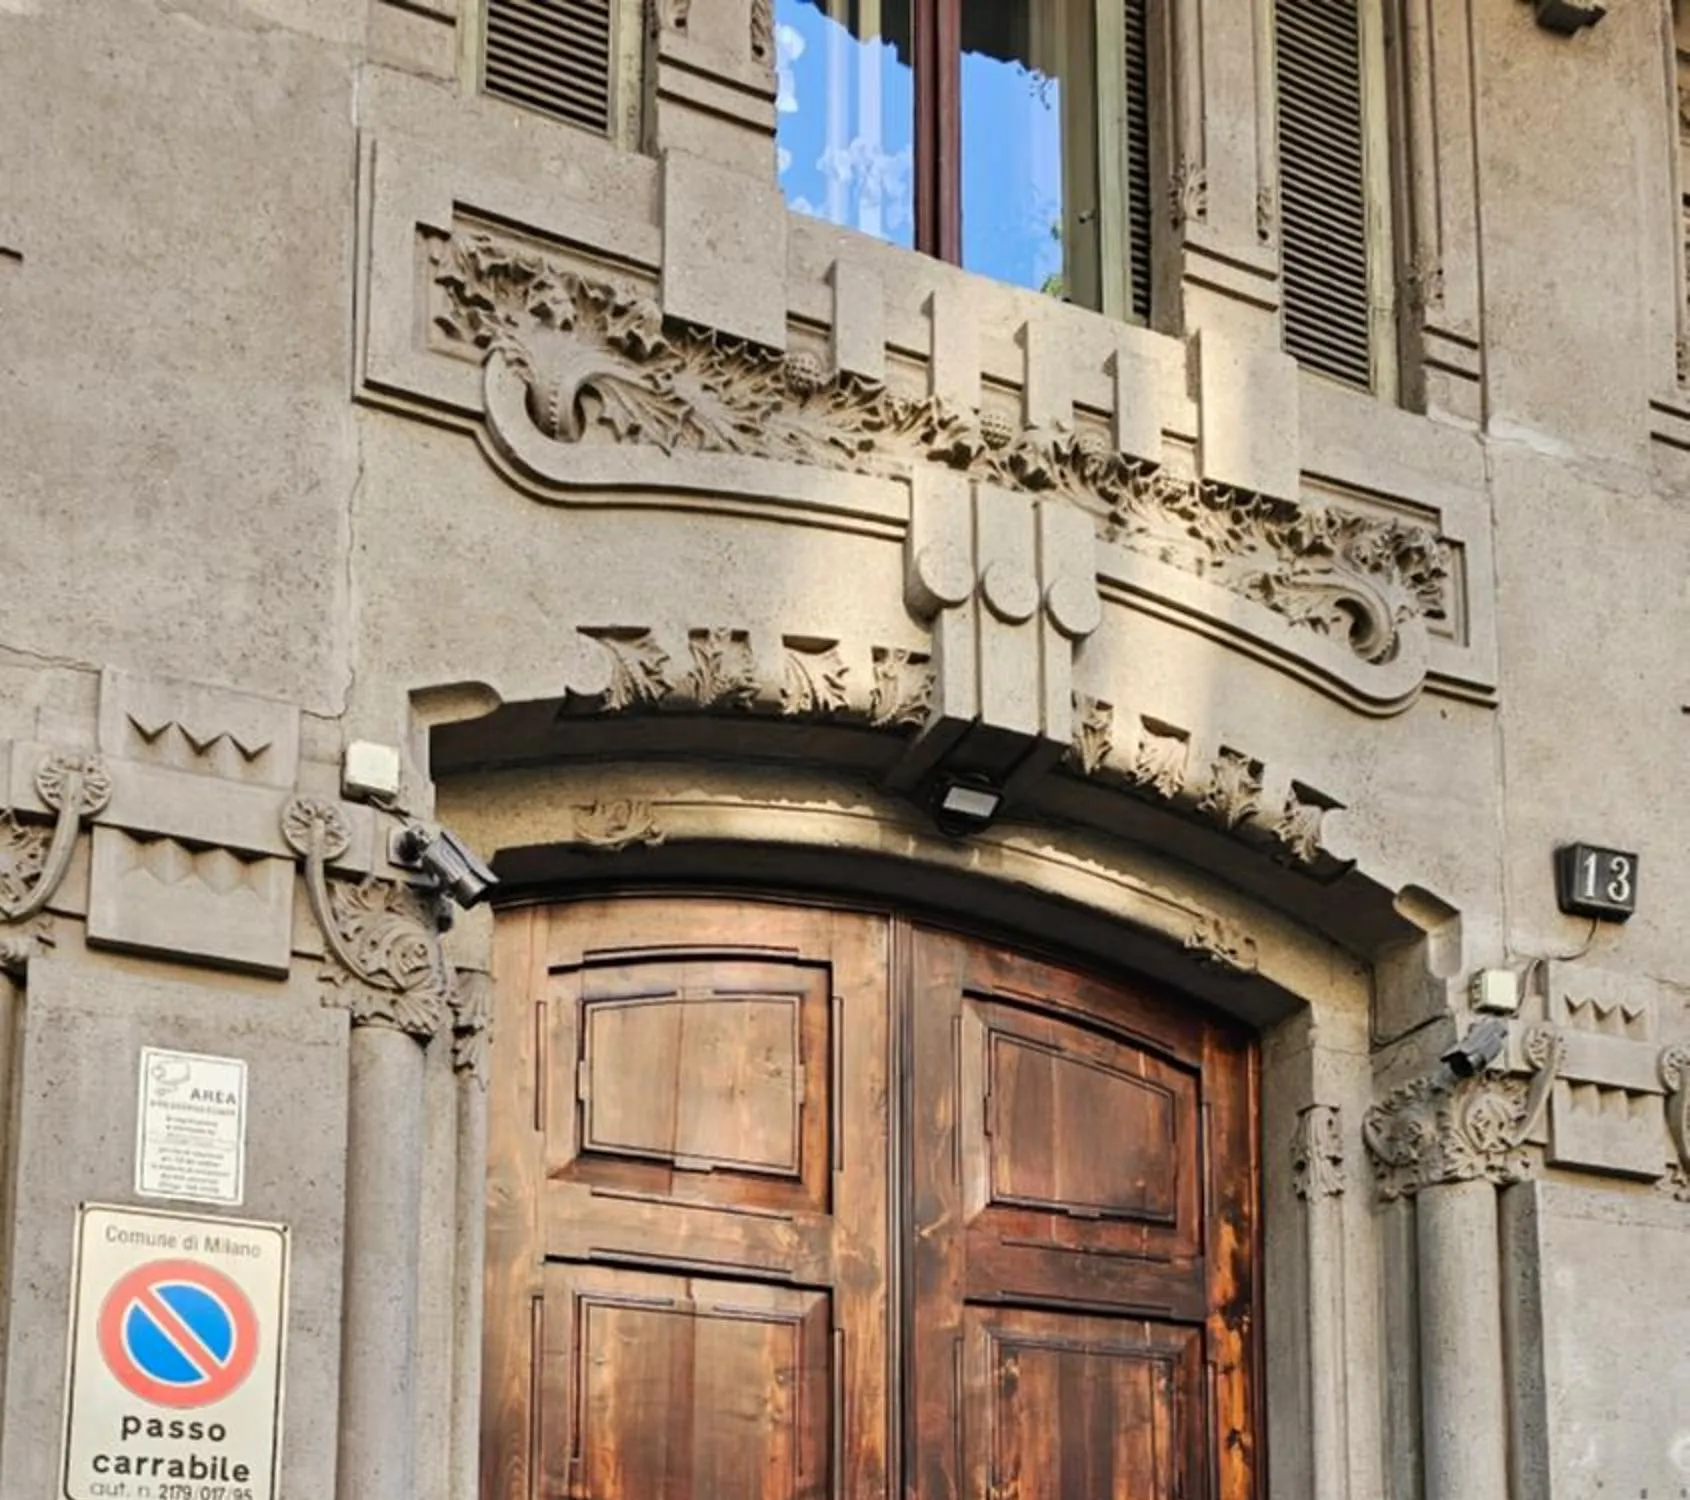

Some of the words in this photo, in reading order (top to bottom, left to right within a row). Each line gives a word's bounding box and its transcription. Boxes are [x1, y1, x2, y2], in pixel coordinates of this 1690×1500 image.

[1583, 852, 1630, 902] 13
[190, 1087, 237, 1105] AREA
[105, 1225, 178, 1248] Comune
[182, 1234, 199, 1251] di
[204, 1236, 262, 1258] Milano
[121, 1415, 226, 1442] passo
[92, 1453, 250, 1482] carrabile
